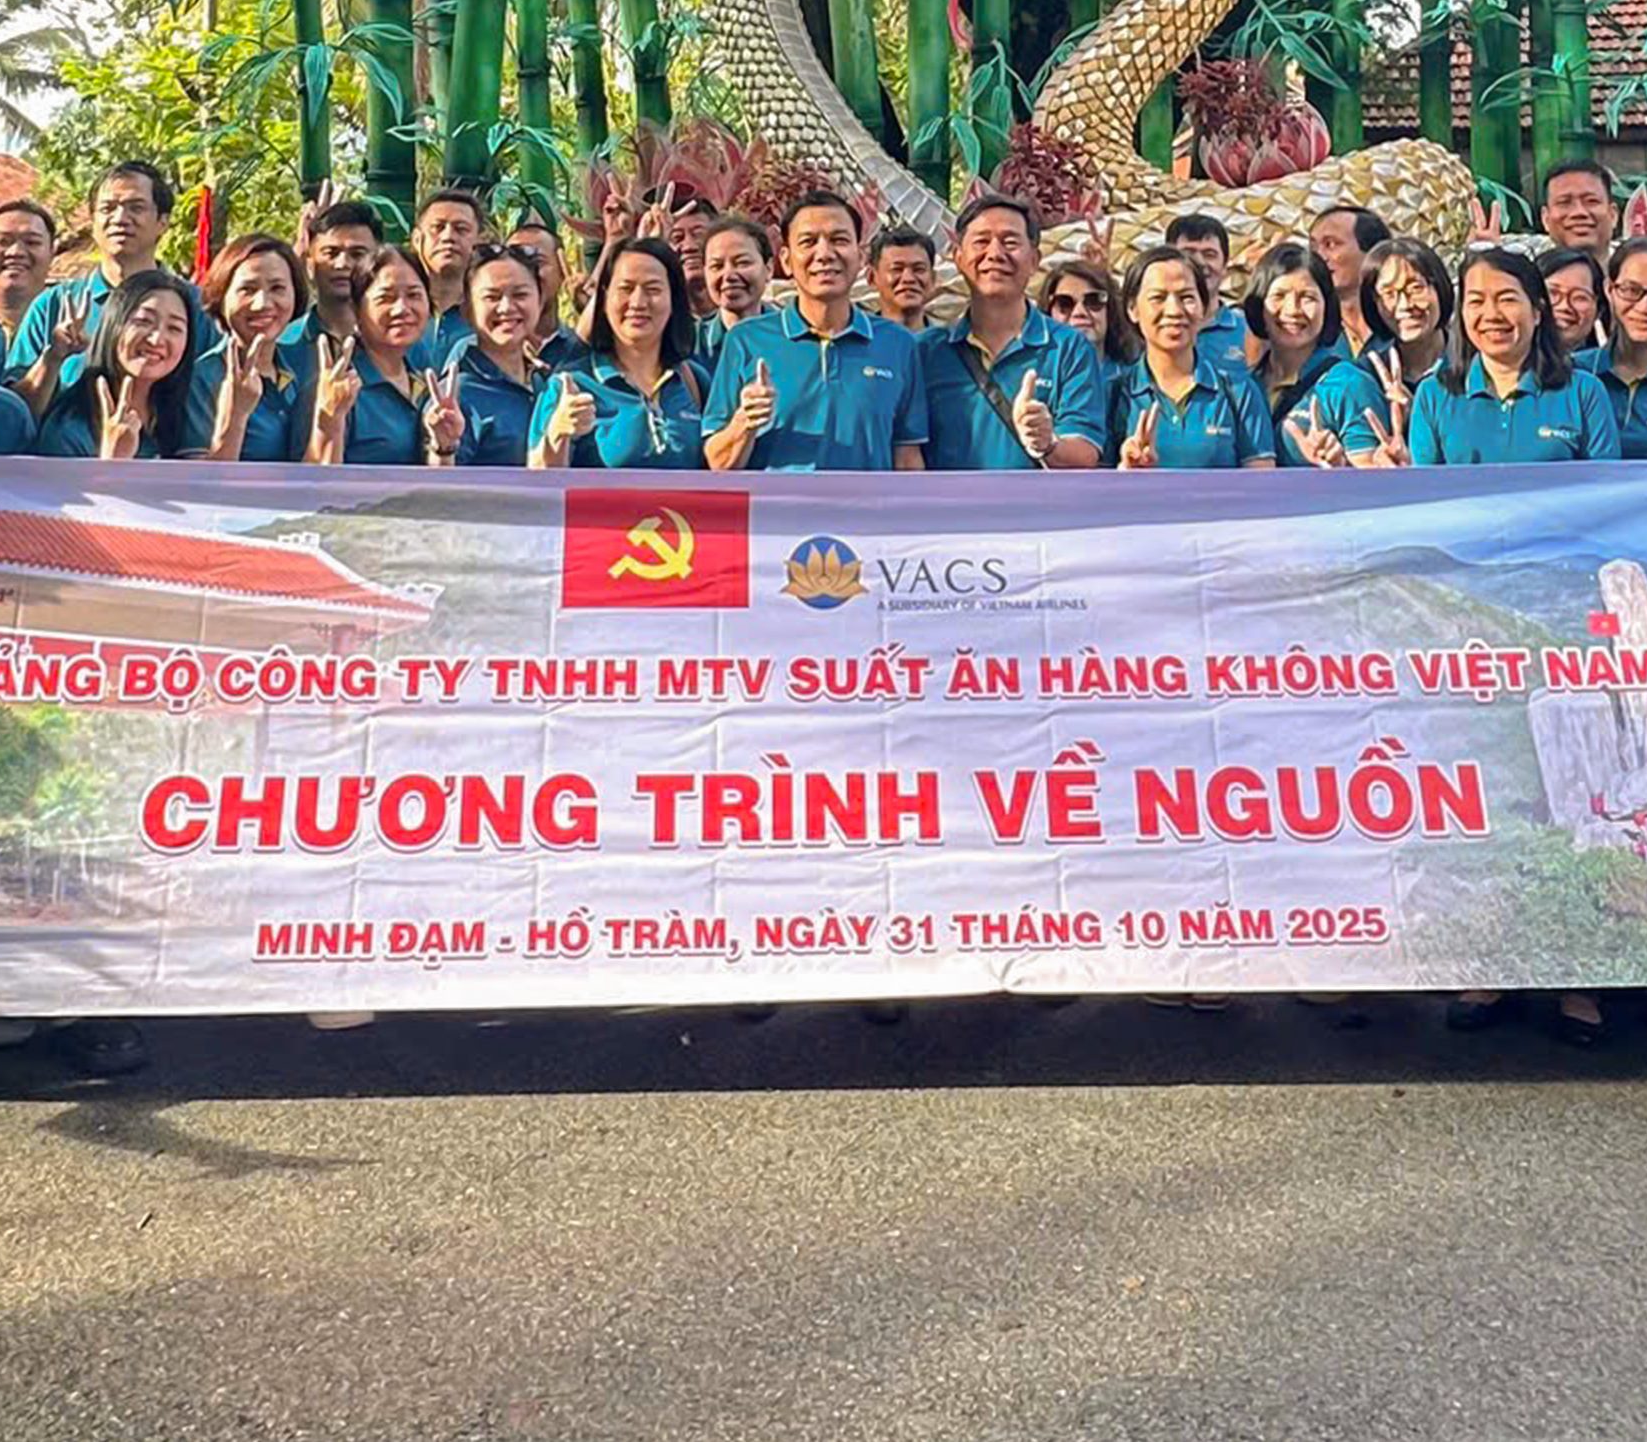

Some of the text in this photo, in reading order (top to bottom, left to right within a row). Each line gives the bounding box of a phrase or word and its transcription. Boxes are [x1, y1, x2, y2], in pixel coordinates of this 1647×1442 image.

[877, 558, 1008, 594] VACS
[123, 649, 202, 708] BỘ
[219, 648, 377, 697] CÔNG
[398, 659, 477, 697] TY
[487, 659, 639, 697] TNHH
[656, 659, 775, 696] MTV
[787, 643, 932, 697] SUẤT
[948, 648, 1019, 695] ĂN
[1039, 648, 1188, 693] HÀNG
[1206, 646, 1395, 691] KHÔNG
[1408, 642, 1529, 702] VIỆT
[141, 736, 1485, 851] CHƯƠNG TRÌNH VỀ NGUỒN
[255, 921, 374, 955] MINH
[387, 921, 487, 968] ĐẠM
[527, 907, 591, 952] HỒ
[603, 909, 742, 958] TRÀM,
[755, 906, 876, 950] NGÀY
[889, 915, 935, 947] 31
[953, 904, 1103, 945] THÁNG
[1117, 911, 1167, 944] 10
[1180, 901, 1275, 943] NĂM
[1287, 907, 1388, 940] 2025
